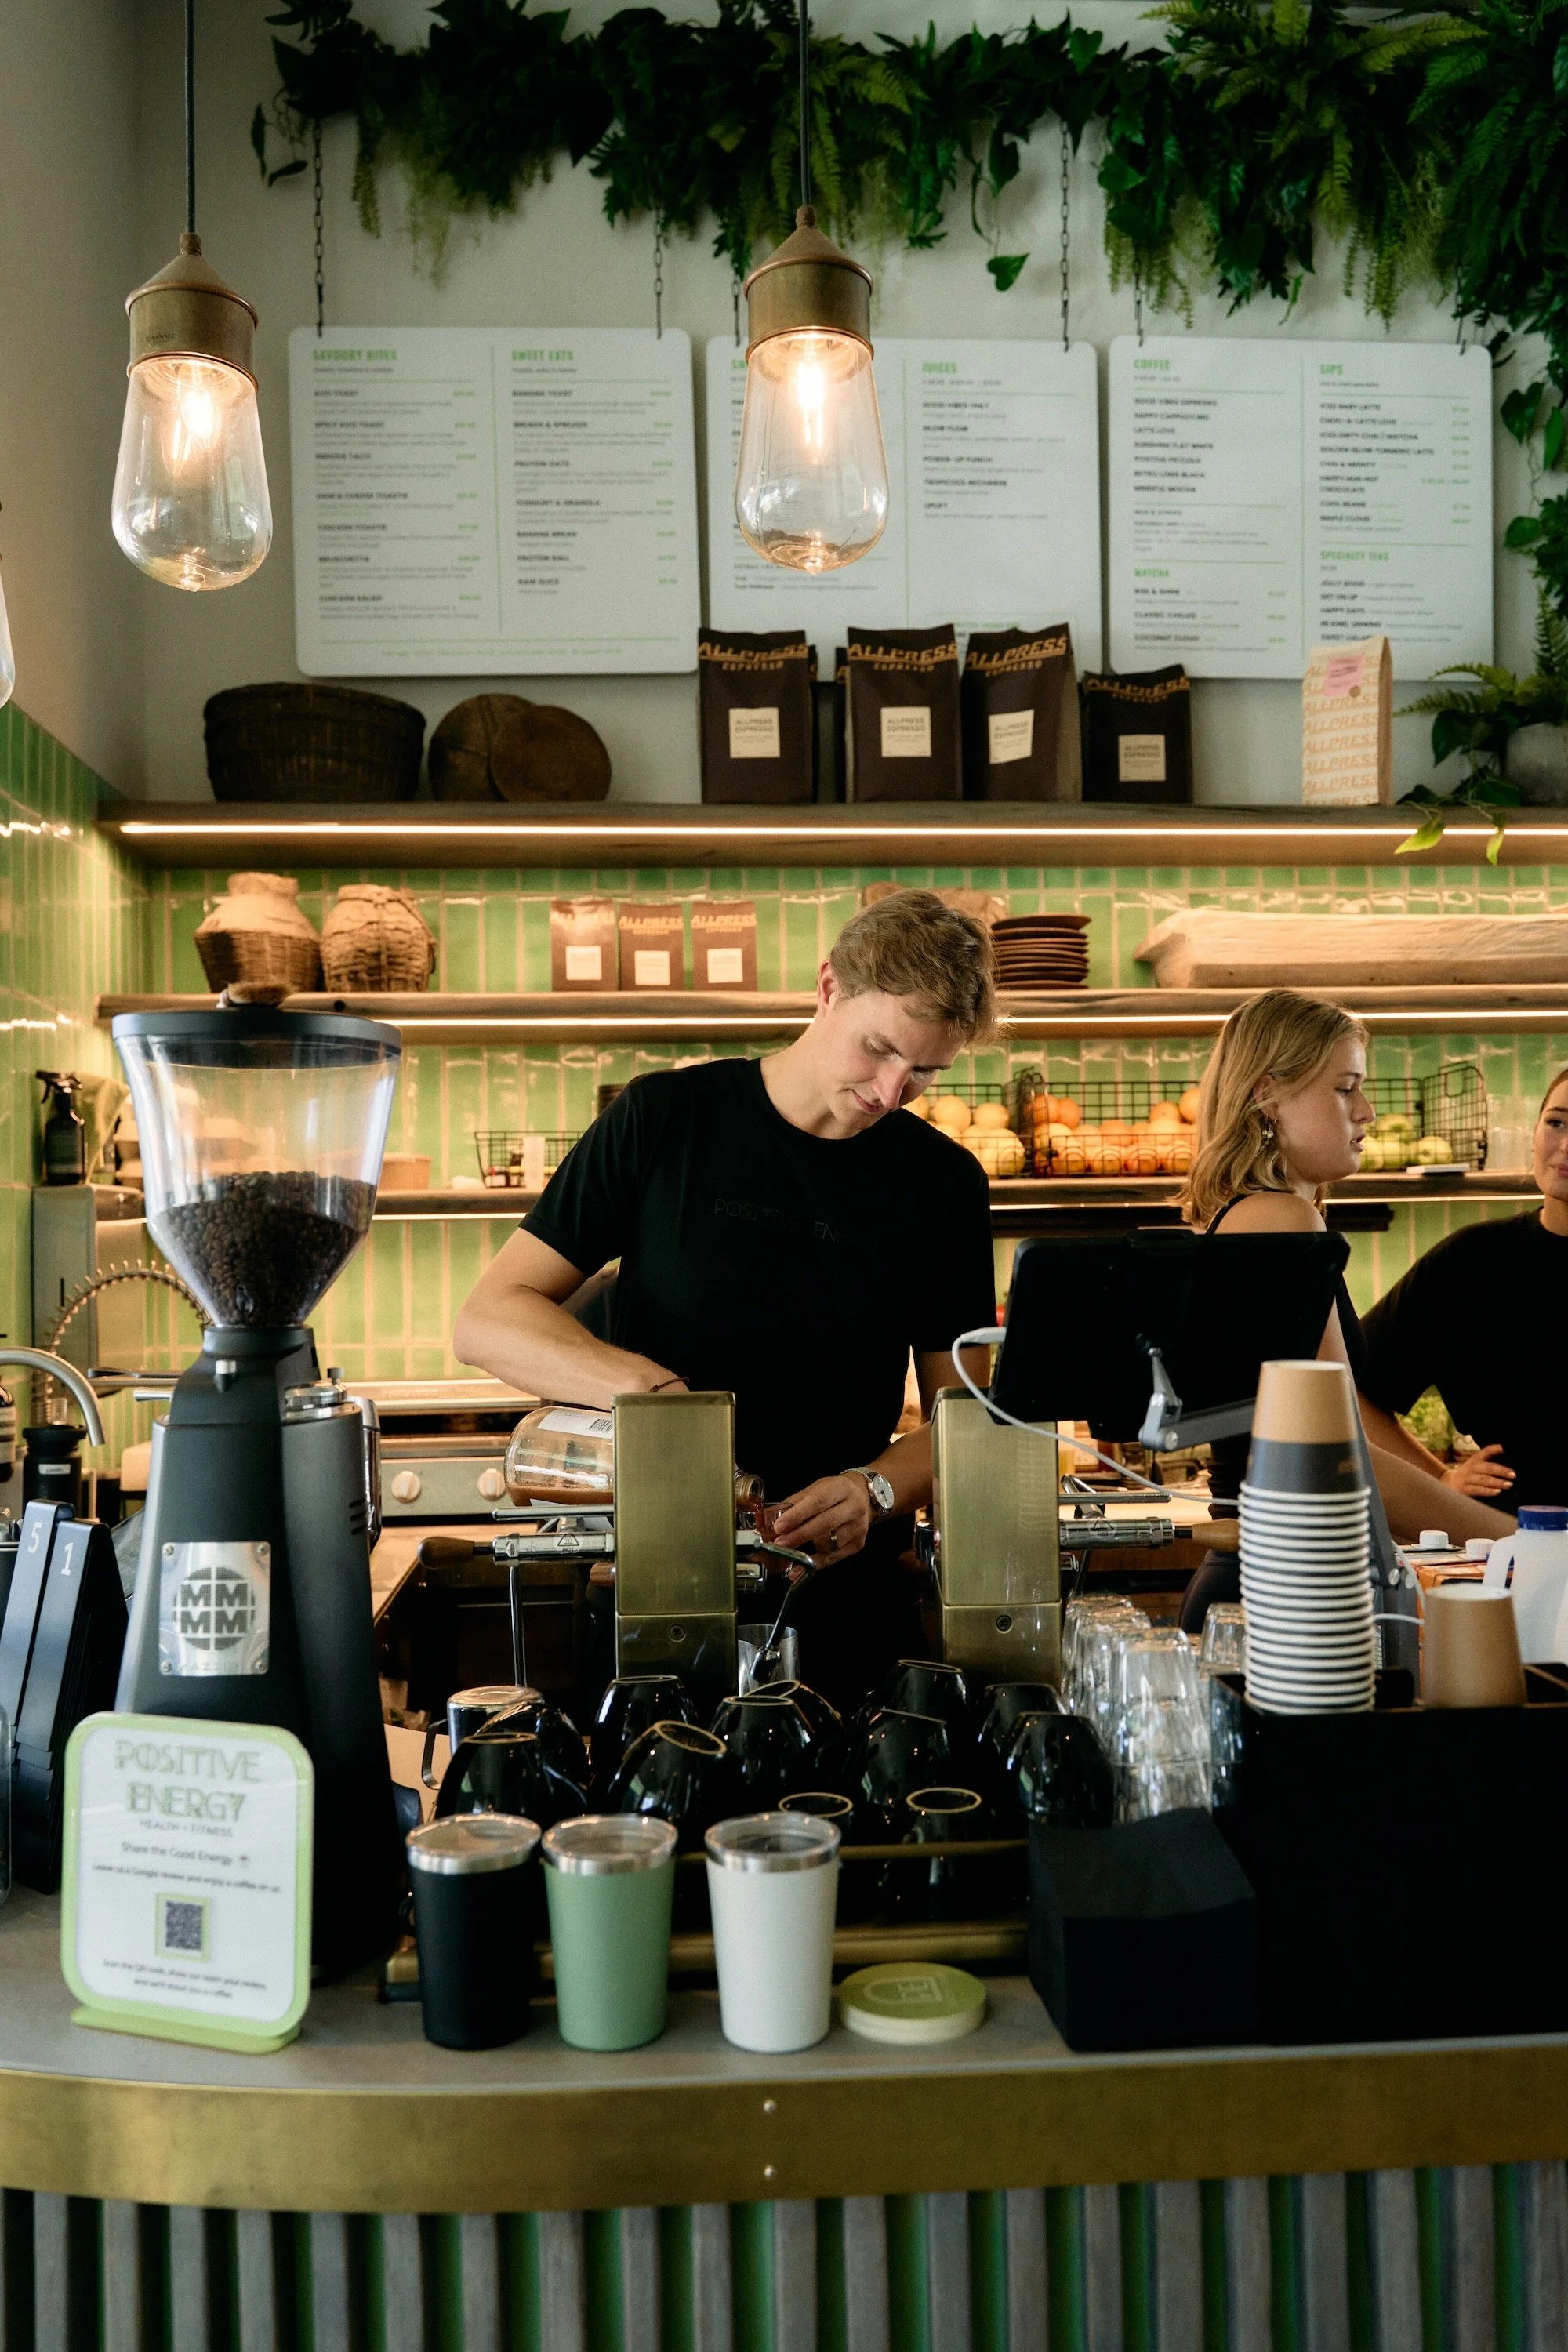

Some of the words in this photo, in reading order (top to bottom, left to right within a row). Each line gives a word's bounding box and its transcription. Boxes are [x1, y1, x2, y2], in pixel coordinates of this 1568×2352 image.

[1134, 359, 1170, 371] COFFEE
[699, 641, 808, 662] ALLPRESS
[848, 641, 958, 662] ALLPRESS
[964, 633, 1068, 670] ALLPRESS
[873, 662, 935, 673] ESPRESSO
[1084, 676, 1189, 696] ALLPRESS
[619, 915, 684, 930] ALLPRESS
[691, 913, 757, 929] ALLPRESS
[27, 1522, 43, 1553] 5
[61, 1542, 74, 1575] 1
[114, 1739, 262, 1783] POSITIVE
[127, 1782, 246, 1823] ENERGY
[140, 1819, 180, 1831] HEALTH
[191, 1824, 233, 1838] FITNESS
[122, 1842, 149, 1854] Share
[151, 1846, 167, 1856] the
[169, 1847, 195, 1860] Good
[198, 1851, 232, 1866] Energy
[132, 1867, 158, 1878] Google
[234, 1880, 256, 1889] coffee
